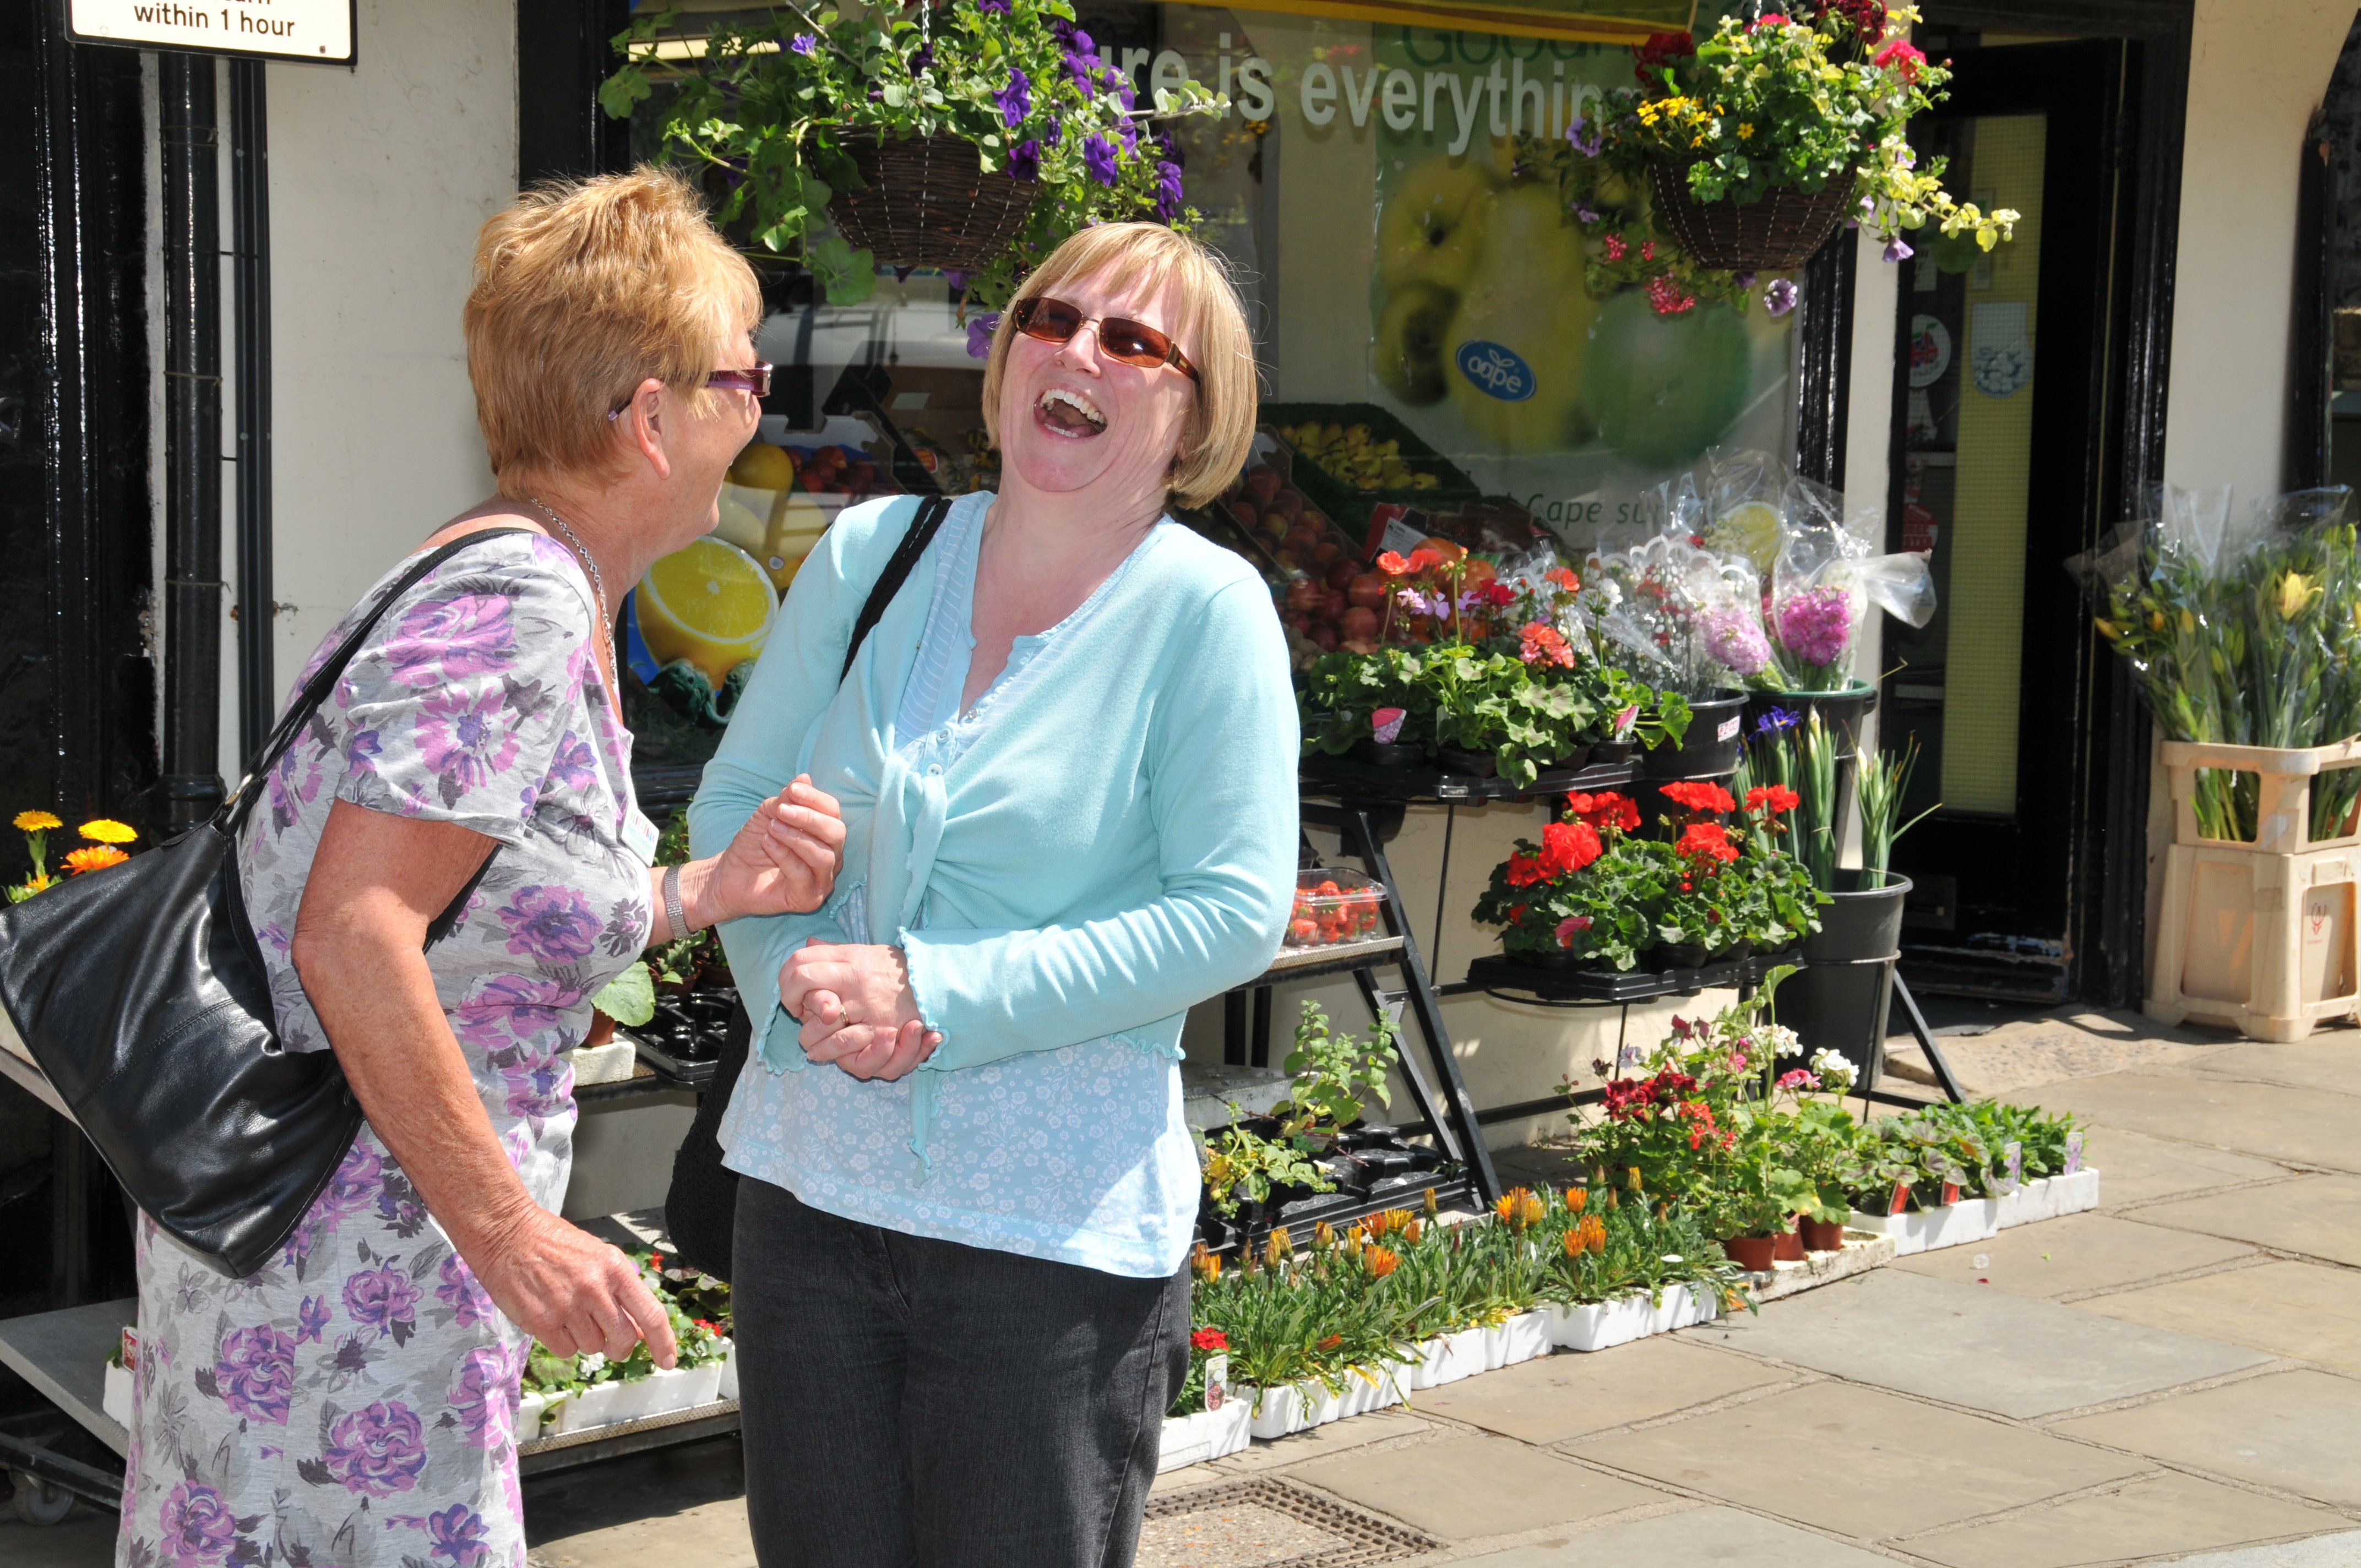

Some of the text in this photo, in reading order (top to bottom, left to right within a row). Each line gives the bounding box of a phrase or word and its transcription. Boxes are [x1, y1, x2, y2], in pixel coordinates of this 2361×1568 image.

[134, 3, 295, 37] within 1 hour
[1219, 32, 1275, 121] is
[1301, 57, 1643, 156] everythin
[1526, 493, 1603, 530] Cape
